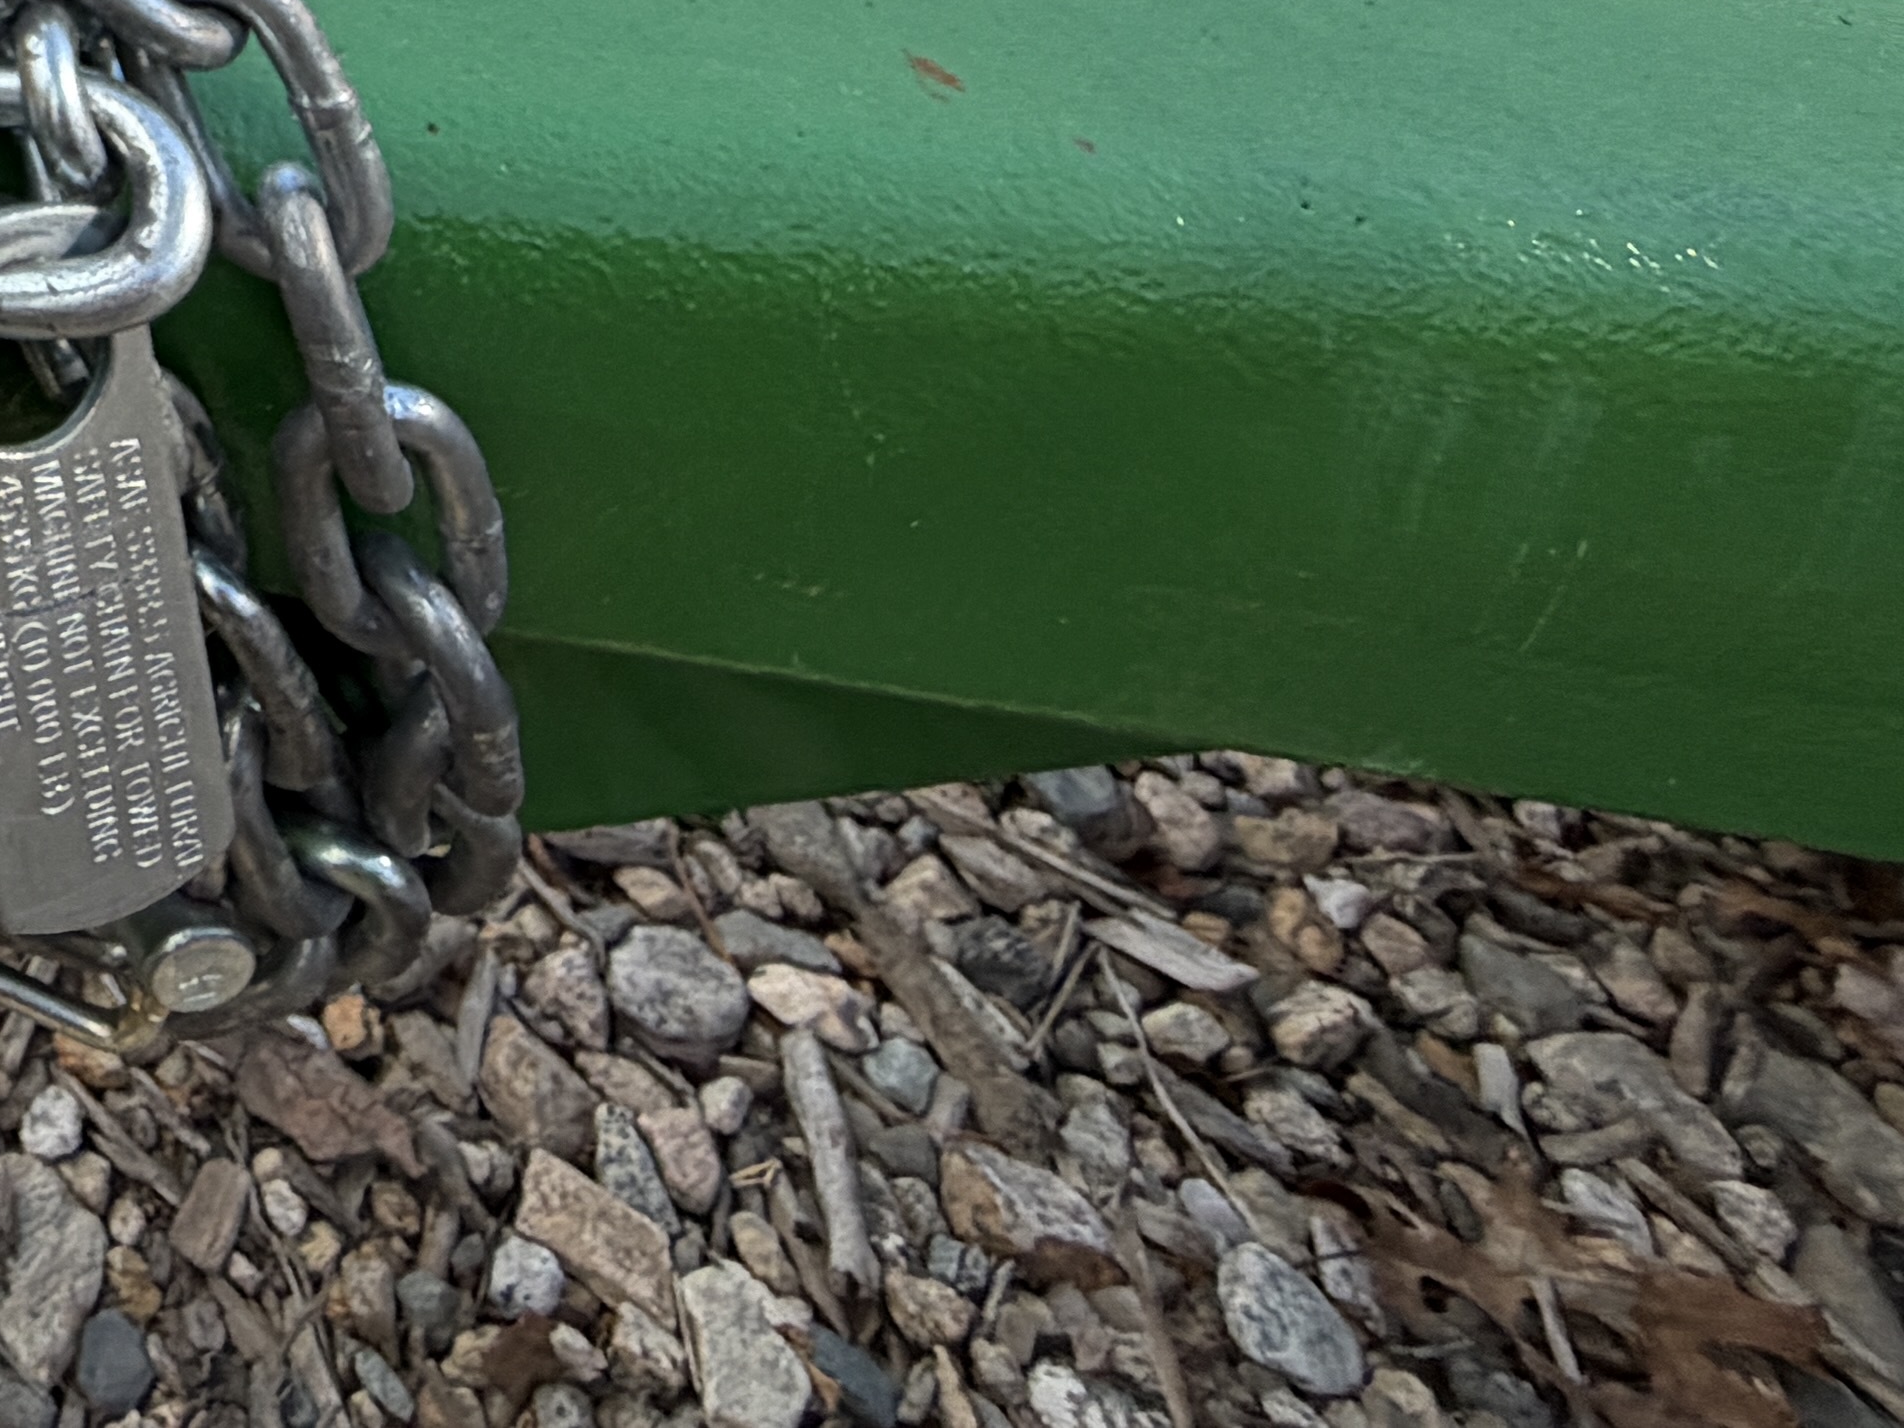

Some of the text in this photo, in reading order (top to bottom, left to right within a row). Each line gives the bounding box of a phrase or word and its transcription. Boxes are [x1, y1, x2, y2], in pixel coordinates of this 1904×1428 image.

[31, 460, 122, 862] MACHINE NOT EXCEEDING
[73, 448, 162, 868] SAFETY CHAIN FOR TOWED
